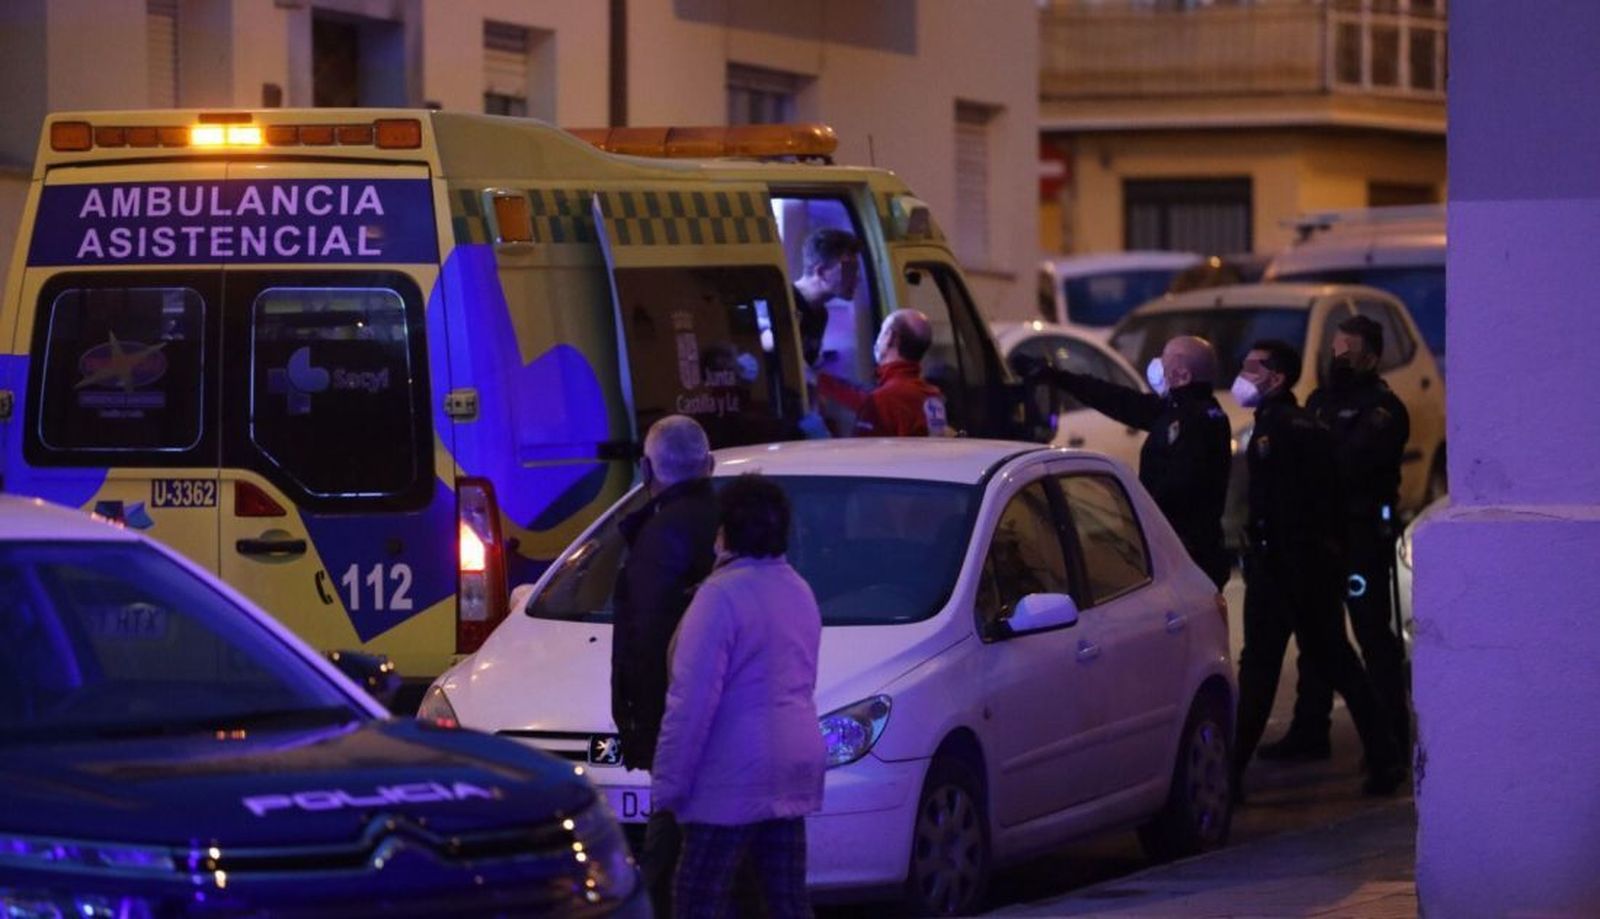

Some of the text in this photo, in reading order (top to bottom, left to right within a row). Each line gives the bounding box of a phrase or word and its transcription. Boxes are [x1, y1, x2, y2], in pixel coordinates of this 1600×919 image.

[79, 184, 385, 218] AMBULANCIA
[76, 225, 382, 258] ASISTENCIAL
[704, 366, 736, 387] Junta
[155, 480, 214, 506] U-3362
[341, 562, 413, 611] 112
[242, 781, 491, 817] POLICIA
